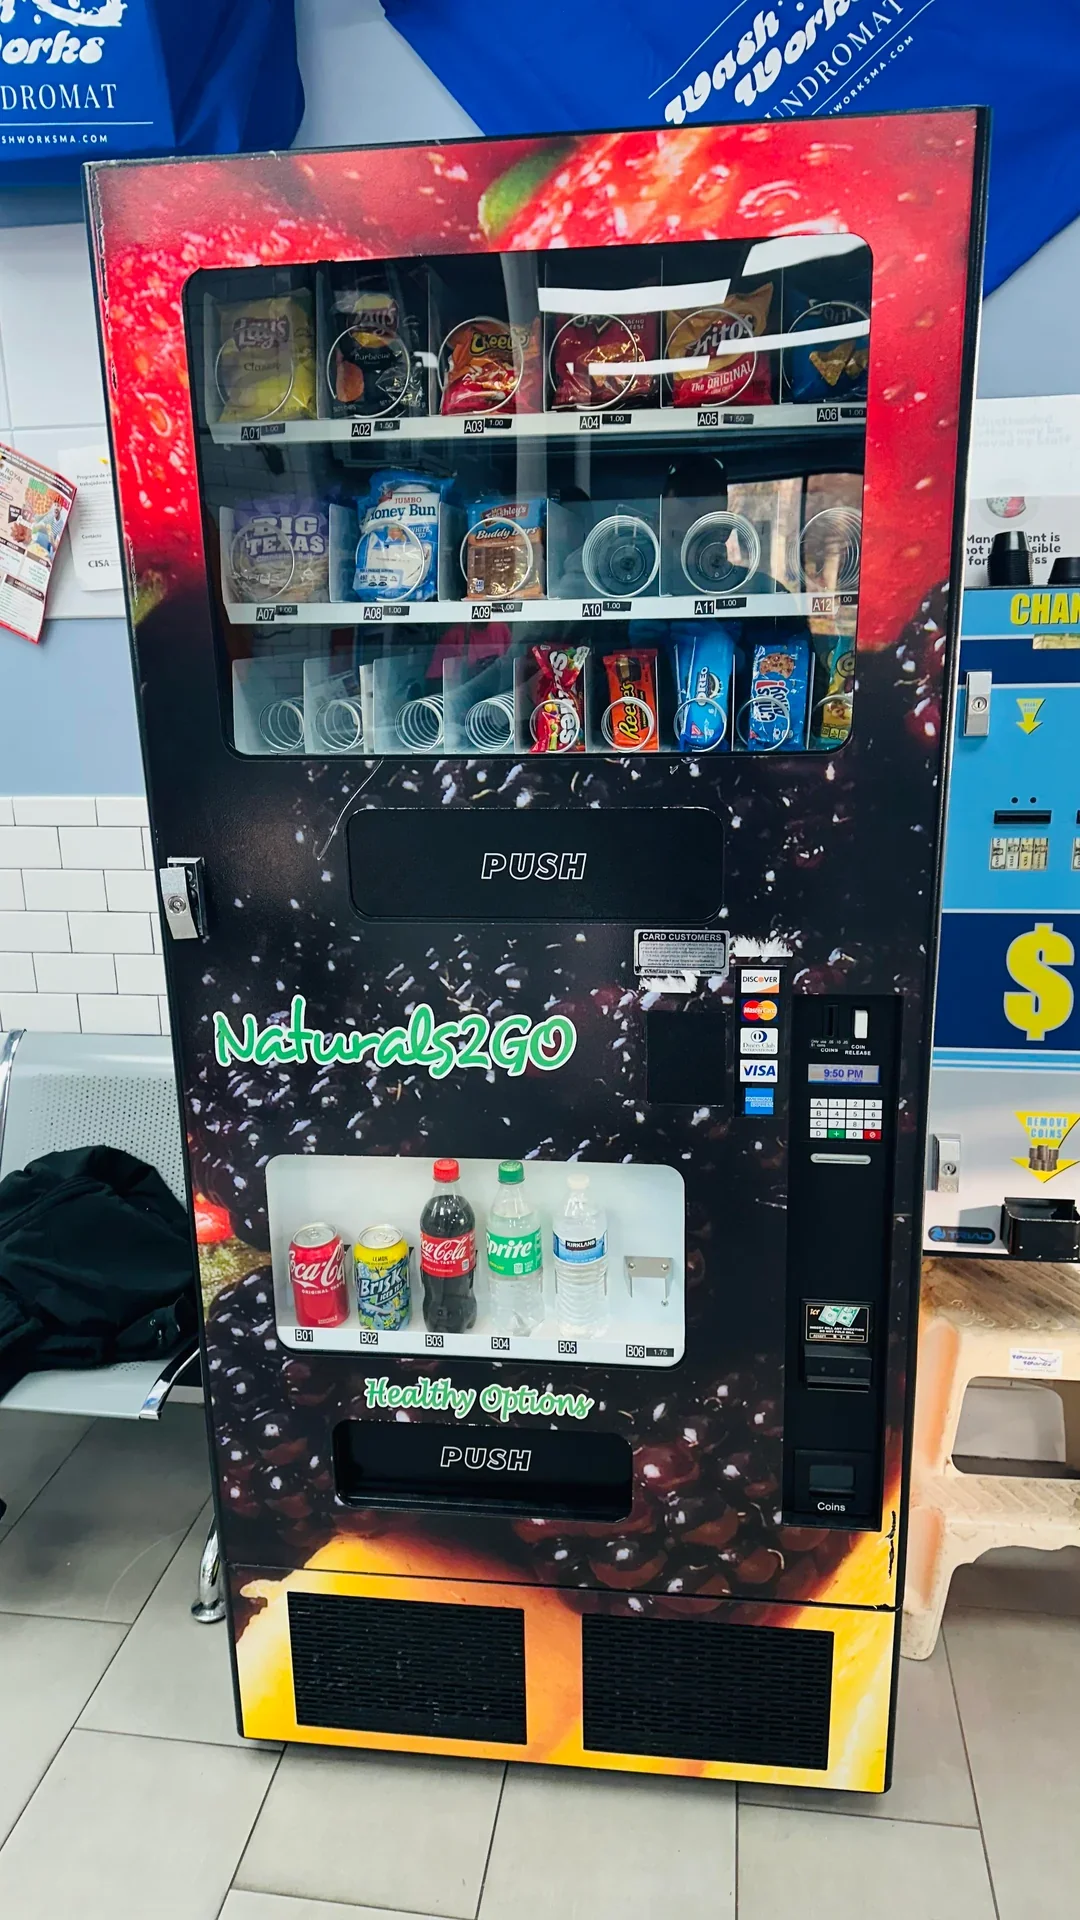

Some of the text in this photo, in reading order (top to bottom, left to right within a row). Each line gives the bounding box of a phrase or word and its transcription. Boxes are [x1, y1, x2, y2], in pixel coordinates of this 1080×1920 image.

[0, 30, 105, 64] orks
[735, 0, 857, 106] Work
[765, 0, 904, 118] NDROMAT
[665, 10, 780, 124] Wash
[0, 83, 117, 110] DROMAT
[691, 361, 752, 391] The ORIGINAL
[698, 412, 718, 425] A05
[818, 408, 837, 420] A06
[465, 420, 483, 433] A03
[580, 416, 599, 429] A04
[241, 427, 260, 439] A01
[352, 423, 370, 436] A02
[395, 496, 422, 504] JUMBO
[408, 503, 437, 516] Bun
[252, 515, 319, 537] BIG
[476, 526, 538, 541] Buddy Brs
[967, 532, 1061, 545] Manent is
[246, 534, 325, 556] TEXAS
[88, 560, 110, 568] CISA
[583, 603, 600, 616] A10
[695, 601, 714, 614] A11
[813, 599, 832, 612] A12
[1011, 593, 1080, 625] CHAN
[257, 608, 274, 620] A07
[365, 607, 382, 619] A08
[473, 607, 490, 618] A09
[697, 667, 708, 706] OREO
[618, 682, 640, 740] Reee's
[481, 852, 587, 880] PUSH
[668, 933, 722, 941] CUSTOMERS
[743, 1005, 777, 1014] MasterCard
[213, 994, 577, 1079] Naturals2GO
[743, 1065, 776, 1076] VISA
[823, 1068, 863, 1078] 9:50 PM
[1027, 1117, 1067, 1127] REMOVE
[1031, 1128, 1062, 1138] COINS
[421, 1236, 469, 1261] ca-Cola
[566, 1240, 595, 1248] KIRKLAND
[380, 1290, 393, 1300] ICED
[296, 1330, 313, 1341] B01
[361, 1333, 378, 1344] B02
[426, 1335, 443, 1347] B03
[492, 1338, 509, 1349] B04
[559, 1341, 576, 1353] B05
[627, 1345, 644, 1357] B06
[364, 1375, 595, 1422] Healthy Options
[440, 1446, 532, 1471] PUSH
[817, 1502, 846, 1512] Coins
